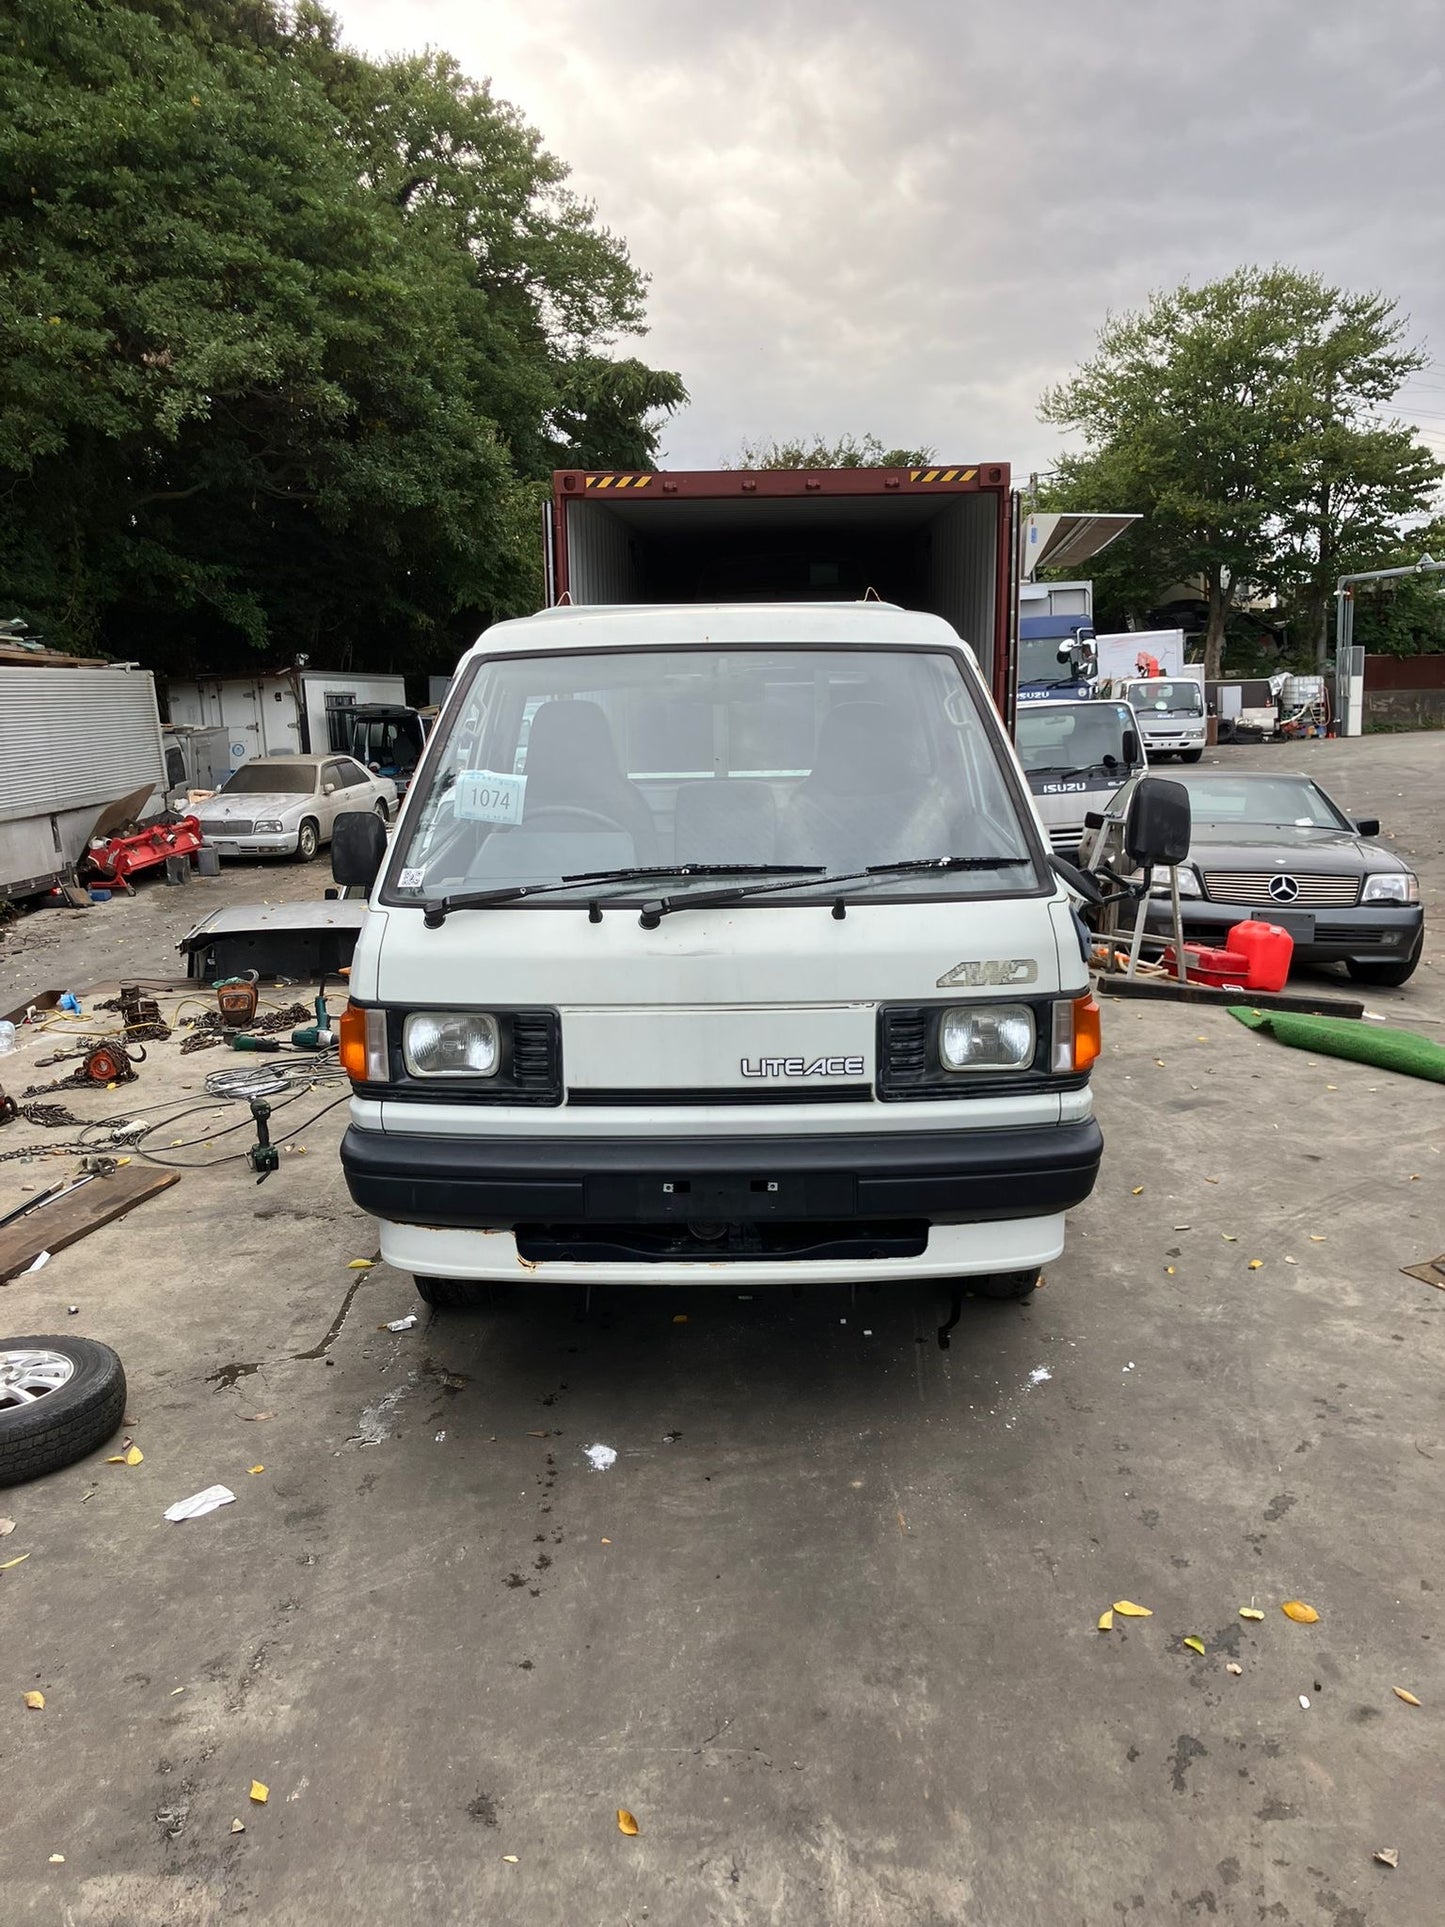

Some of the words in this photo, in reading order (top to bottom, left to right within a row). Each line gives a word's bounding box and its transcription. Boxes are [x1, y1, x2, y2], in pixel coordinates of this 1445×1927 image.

[471, 787, 510, 810] 1074
[1043, 782, 1087, 793] ISUZU
[936, 959, 1038, 988] 4WD
